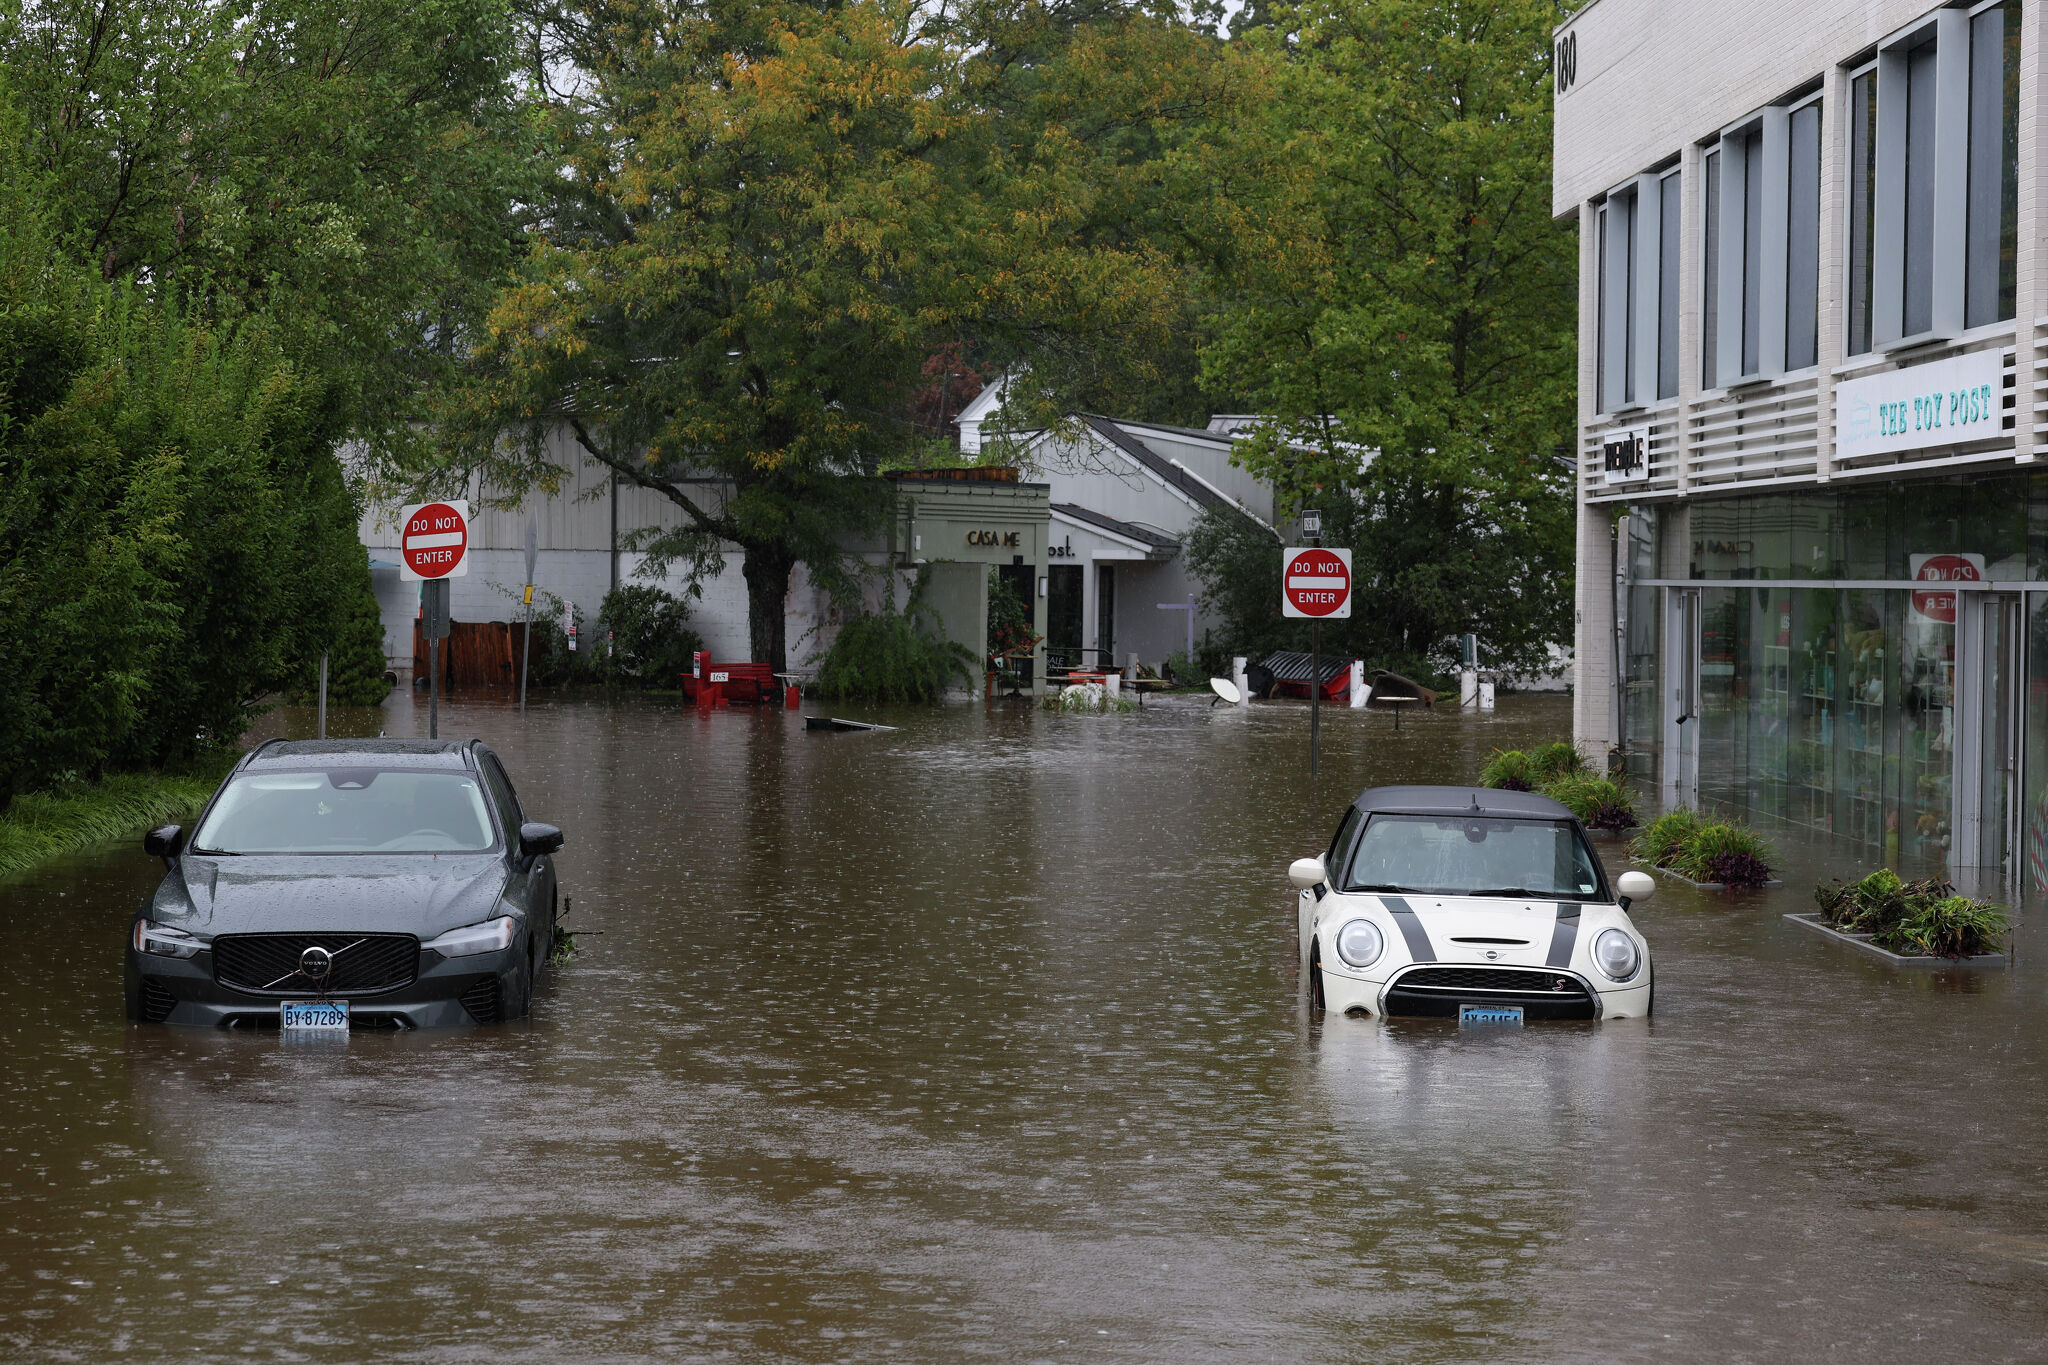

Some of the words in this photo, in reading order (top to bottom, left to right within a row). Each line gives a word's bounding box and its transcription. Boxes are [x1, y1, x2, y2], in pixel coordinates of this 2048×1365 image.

[1557, 30, 1576, 95] 180
[1880, 400, 1907, 435] THE
[1914, 392, 1942, 430] TOY
[1950, 384, 1990, 425] POST
[412, 520, 428, 531] DO
[435, 517, 458, 529] NOT
[967, 530, 999, 546] CASA
[1003, 531, 1020, 546] ME
[416, 551, 452, 564] ENTER
[1295, 563, 1310, 573] DO
[1318, 563, 1340, 573] NOT
[1298, 593, 1335, 603] ENTER
